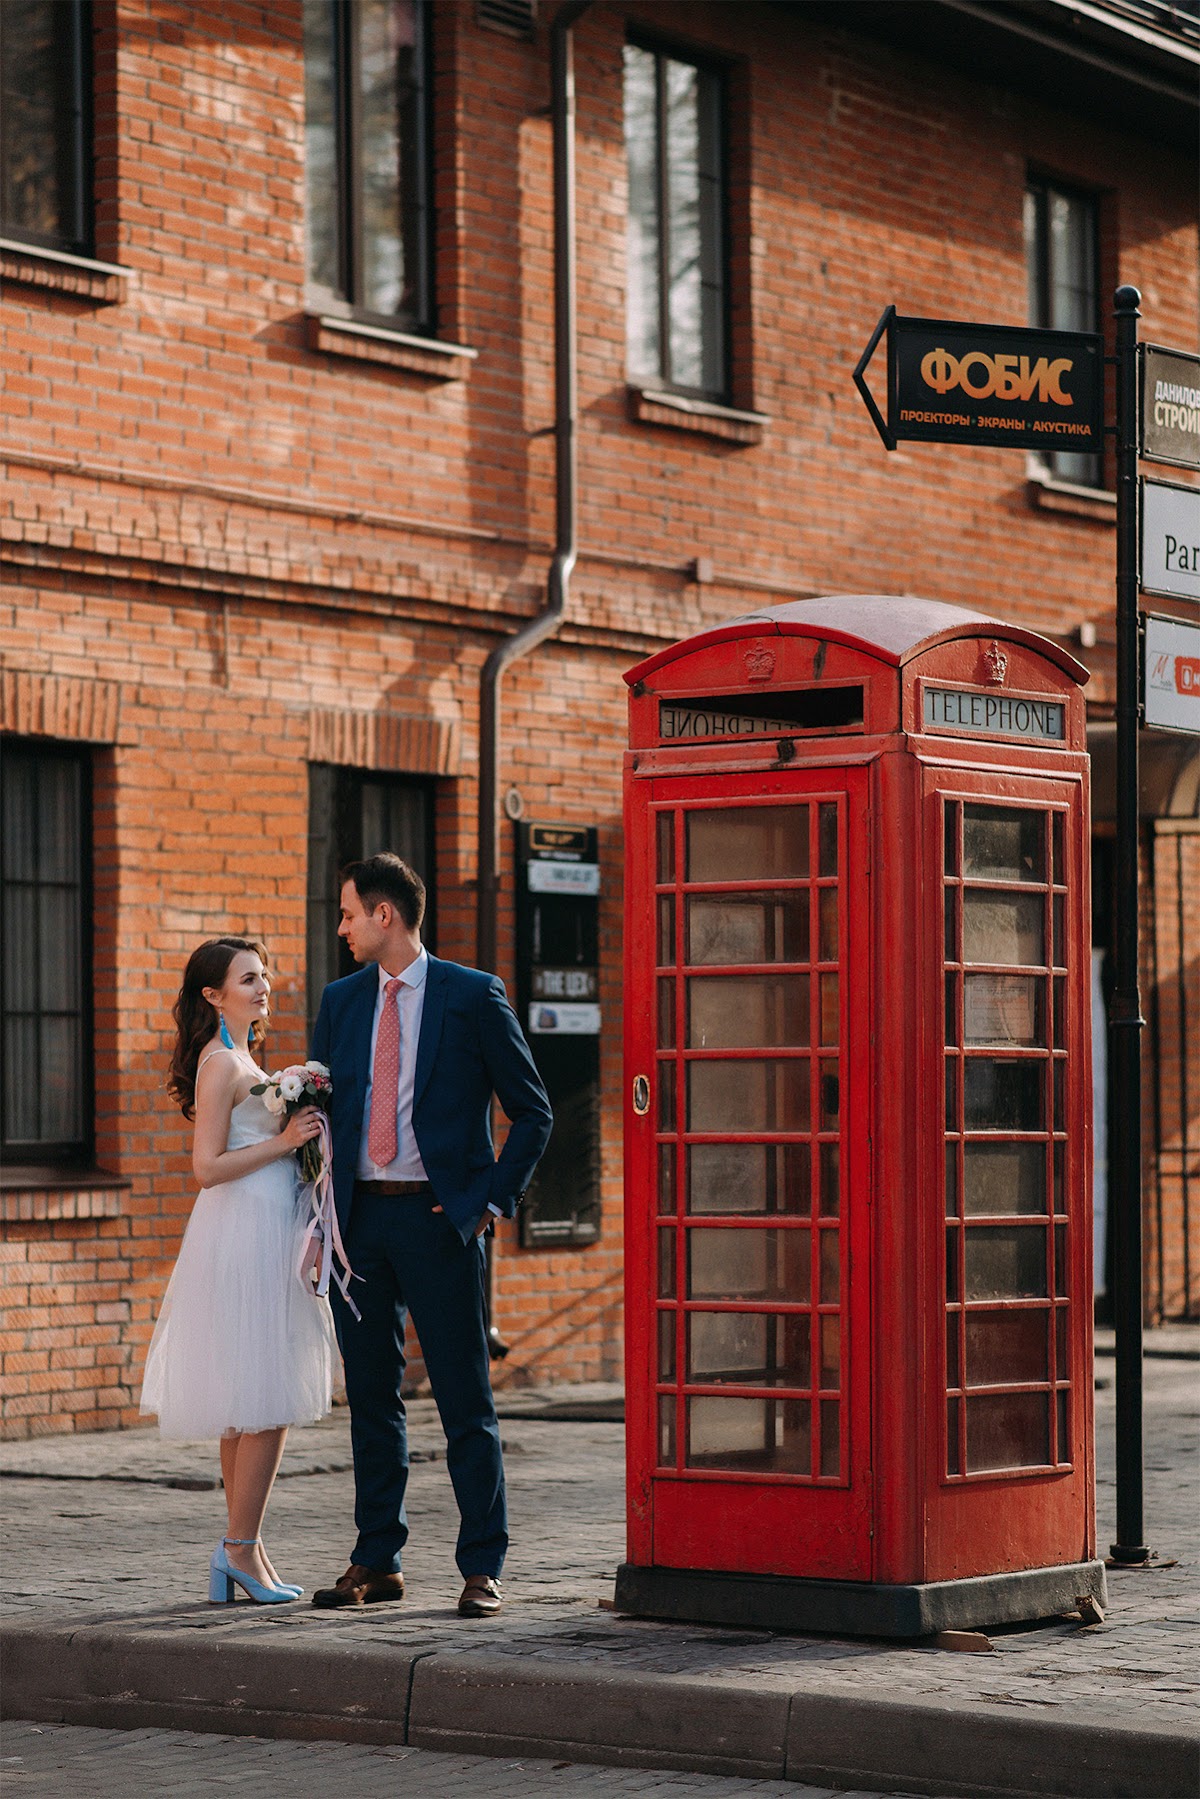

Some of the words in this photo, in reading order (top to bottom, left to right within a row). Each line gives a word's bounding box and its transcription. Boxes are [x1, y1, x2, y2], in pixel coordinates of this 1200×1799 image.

[921, 347, 1074, 406] ФОБИС
[900, 409, 970, 426] ПРОЕКТОРЫ
[977, 415, 1025, 431] ЭКРАНЫ
[1032, 420, 1092, 436] АКУСТИКА
[1154, 400, 1200, 434] СТРОИ
[1165, 534, 1200, 571] Par
[926, 691, 1057, 735] TELEPHONE
